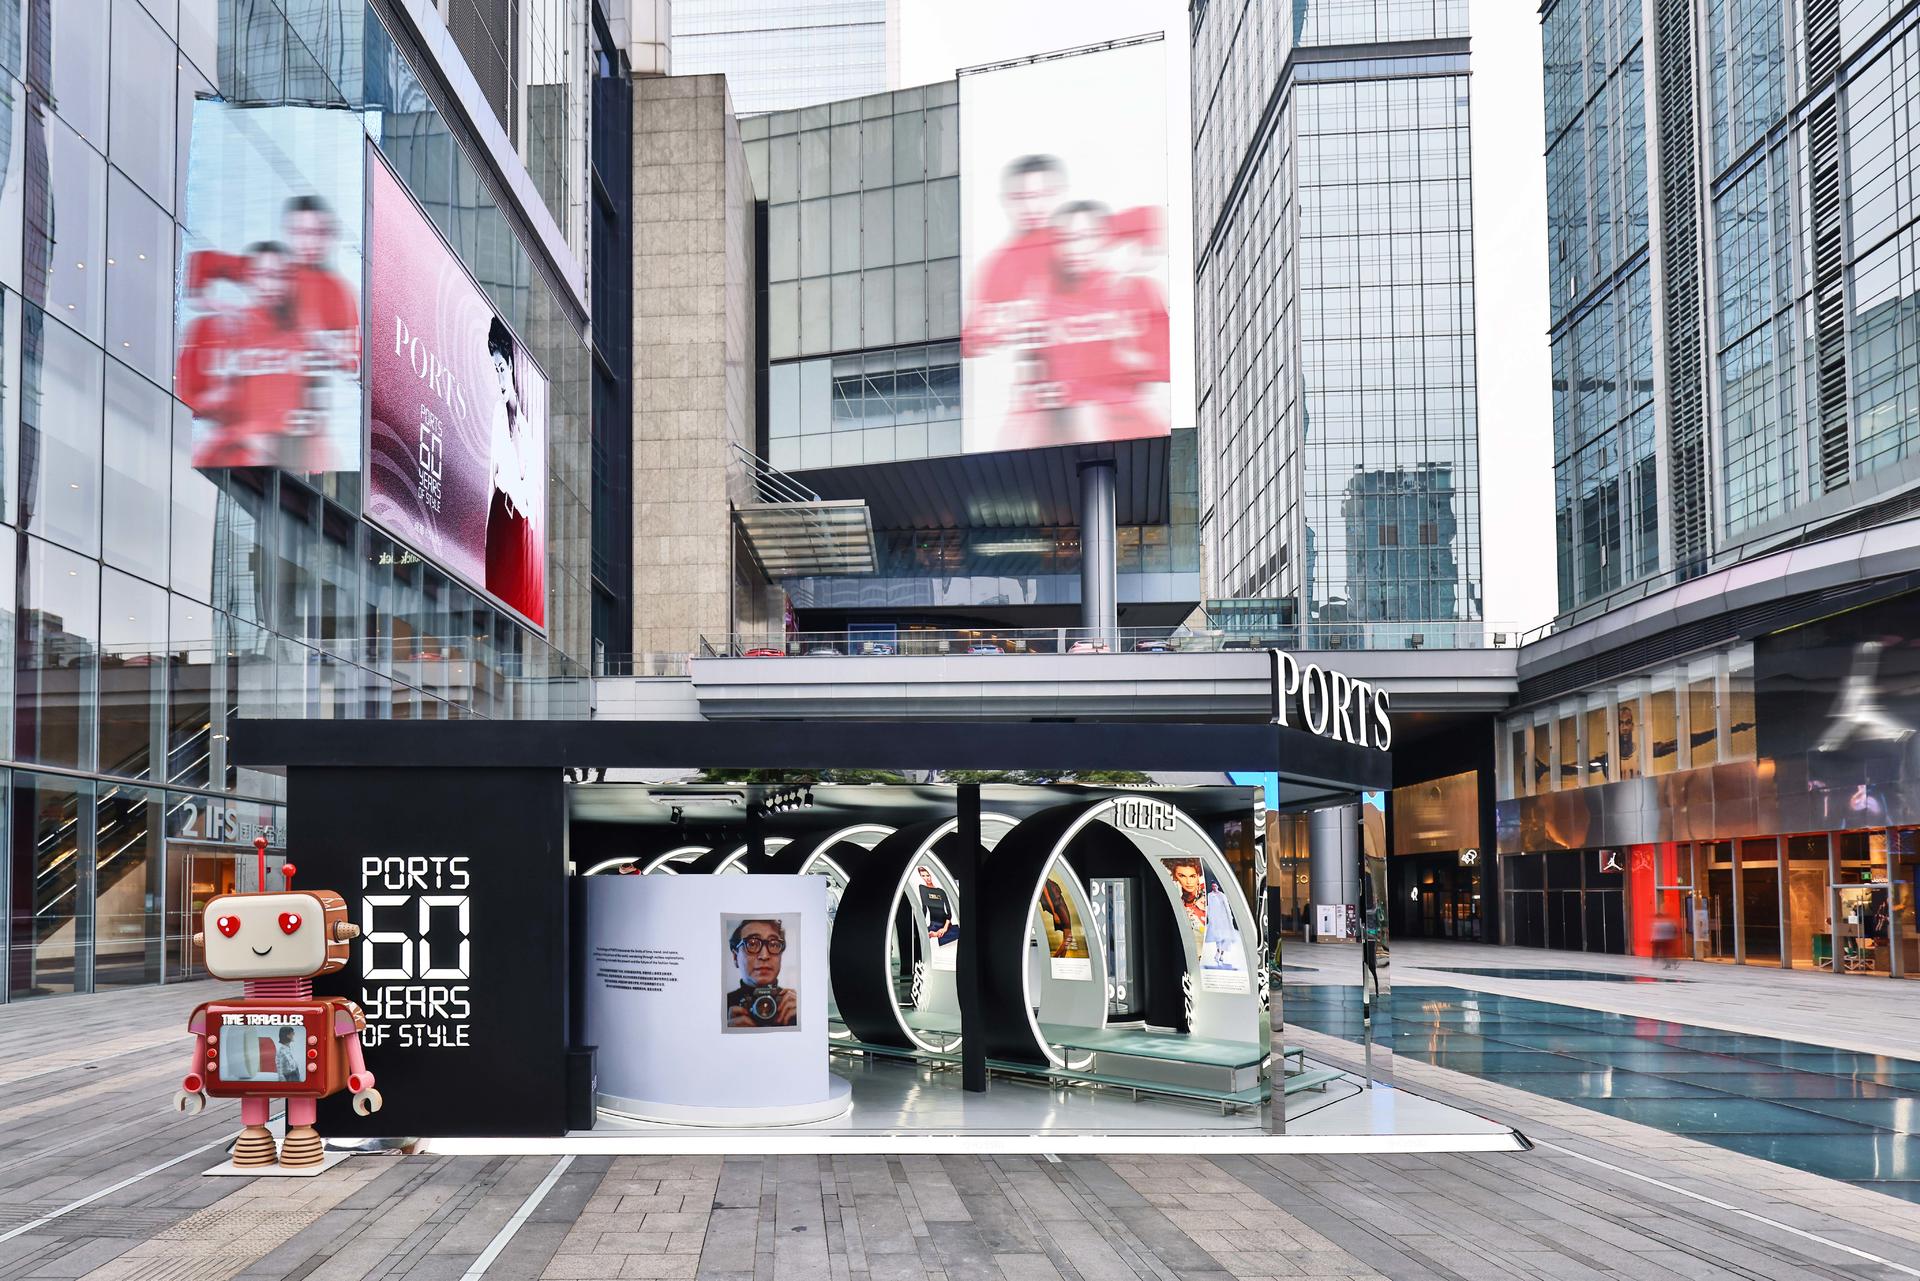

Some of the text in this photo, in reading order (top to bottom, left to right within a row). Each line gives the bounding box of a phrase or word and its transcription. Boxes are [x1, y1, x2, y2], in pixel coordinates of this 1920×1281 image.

[394, 315, 467, 420] PORTS
[420, 403, 443, 437] PORTS
[419, 422, 442, 481] 60
[417, 486, 441, 513] OF STYLE
[418, 467, 442, 500] YEARS
[1273, 648, 1392, 752] PORTS
[182, 803, 238, 839] 2 IFS
[1112, 799, 1177, 831] TODAY
[362, 856, 470, 890] PORTS
[362, 895, 470, 980] 60
[362, 986, 471, 1019] YEARS
[221, 1014, 304, 1026] TIME TRAVELLER
[362, 1023, 471, 1047] OF STYLE
